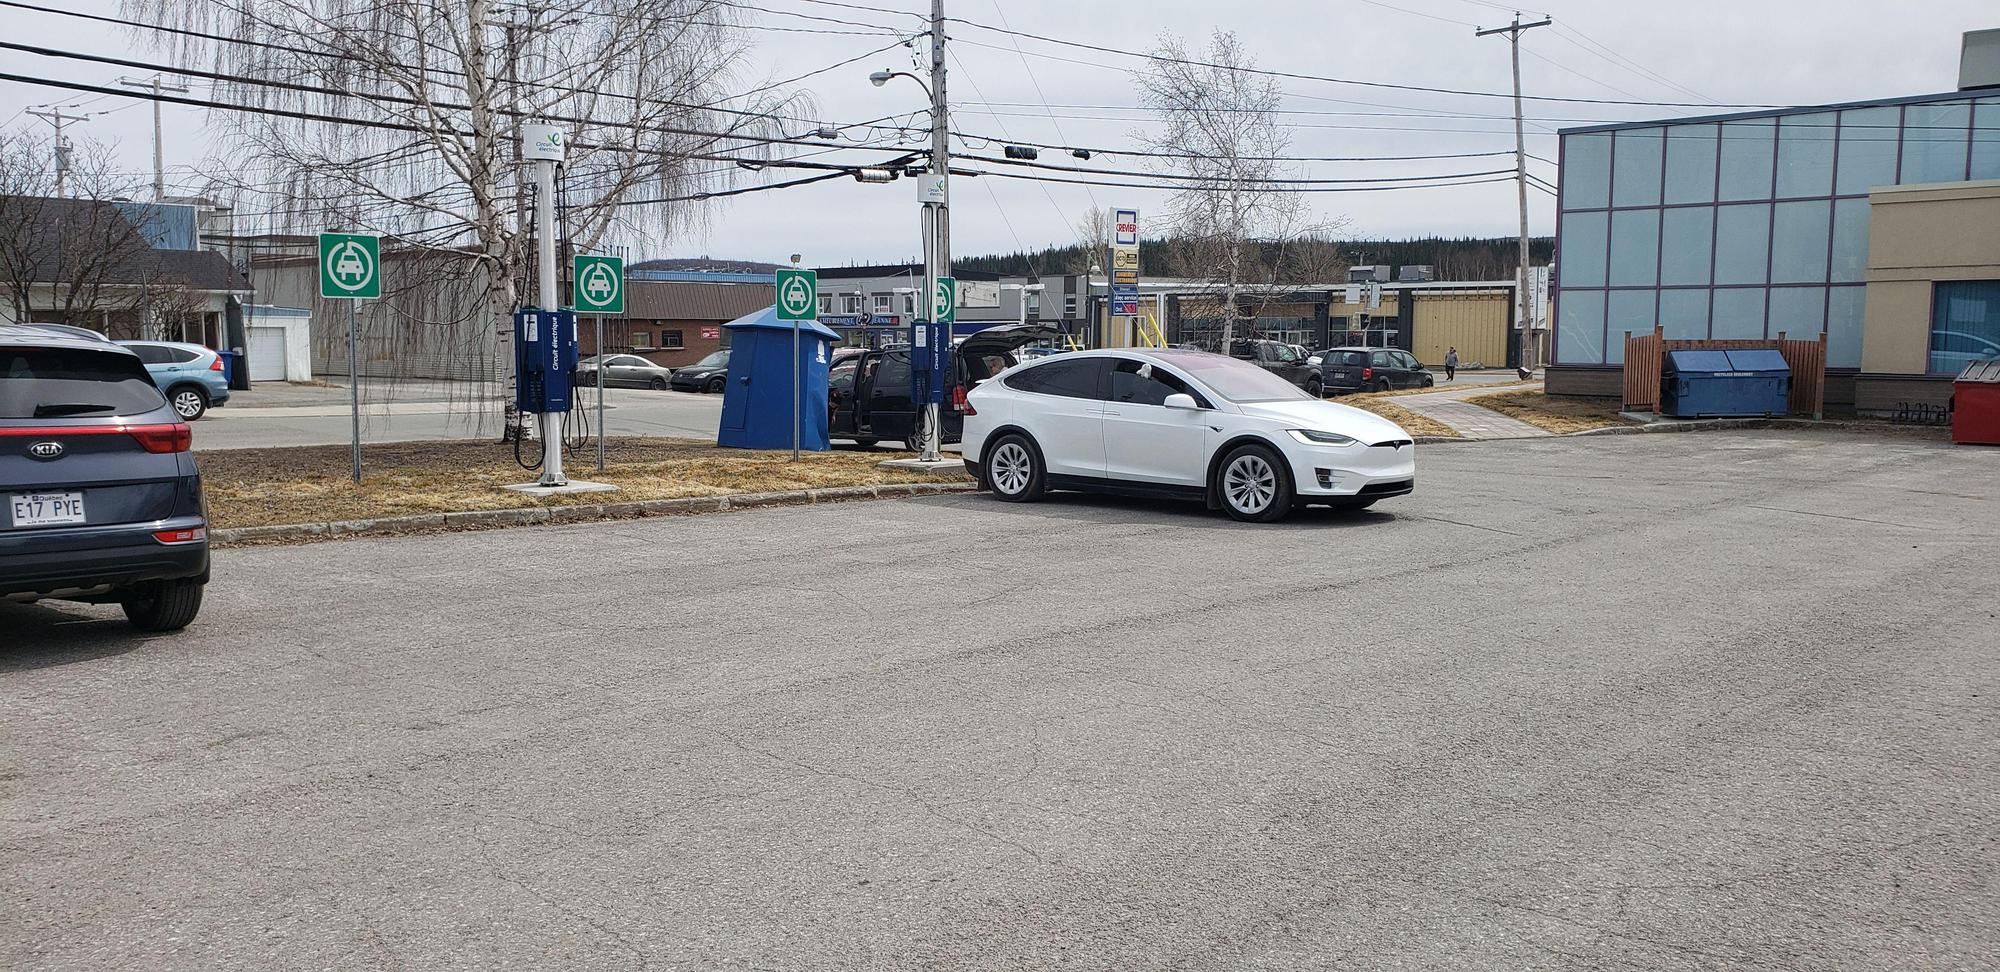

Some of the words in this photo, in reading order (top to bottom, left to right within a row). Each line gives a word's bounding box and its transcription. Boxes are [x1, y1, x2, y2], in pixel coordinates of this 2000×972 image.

[1115, 222, 1136, 232] CREVIER
[551, 316, 559, 348] électrique
[36, 445, 58, 454] KIA
[15, 502, 43, 519] E17
[53, 500, 82, 517] PYE
